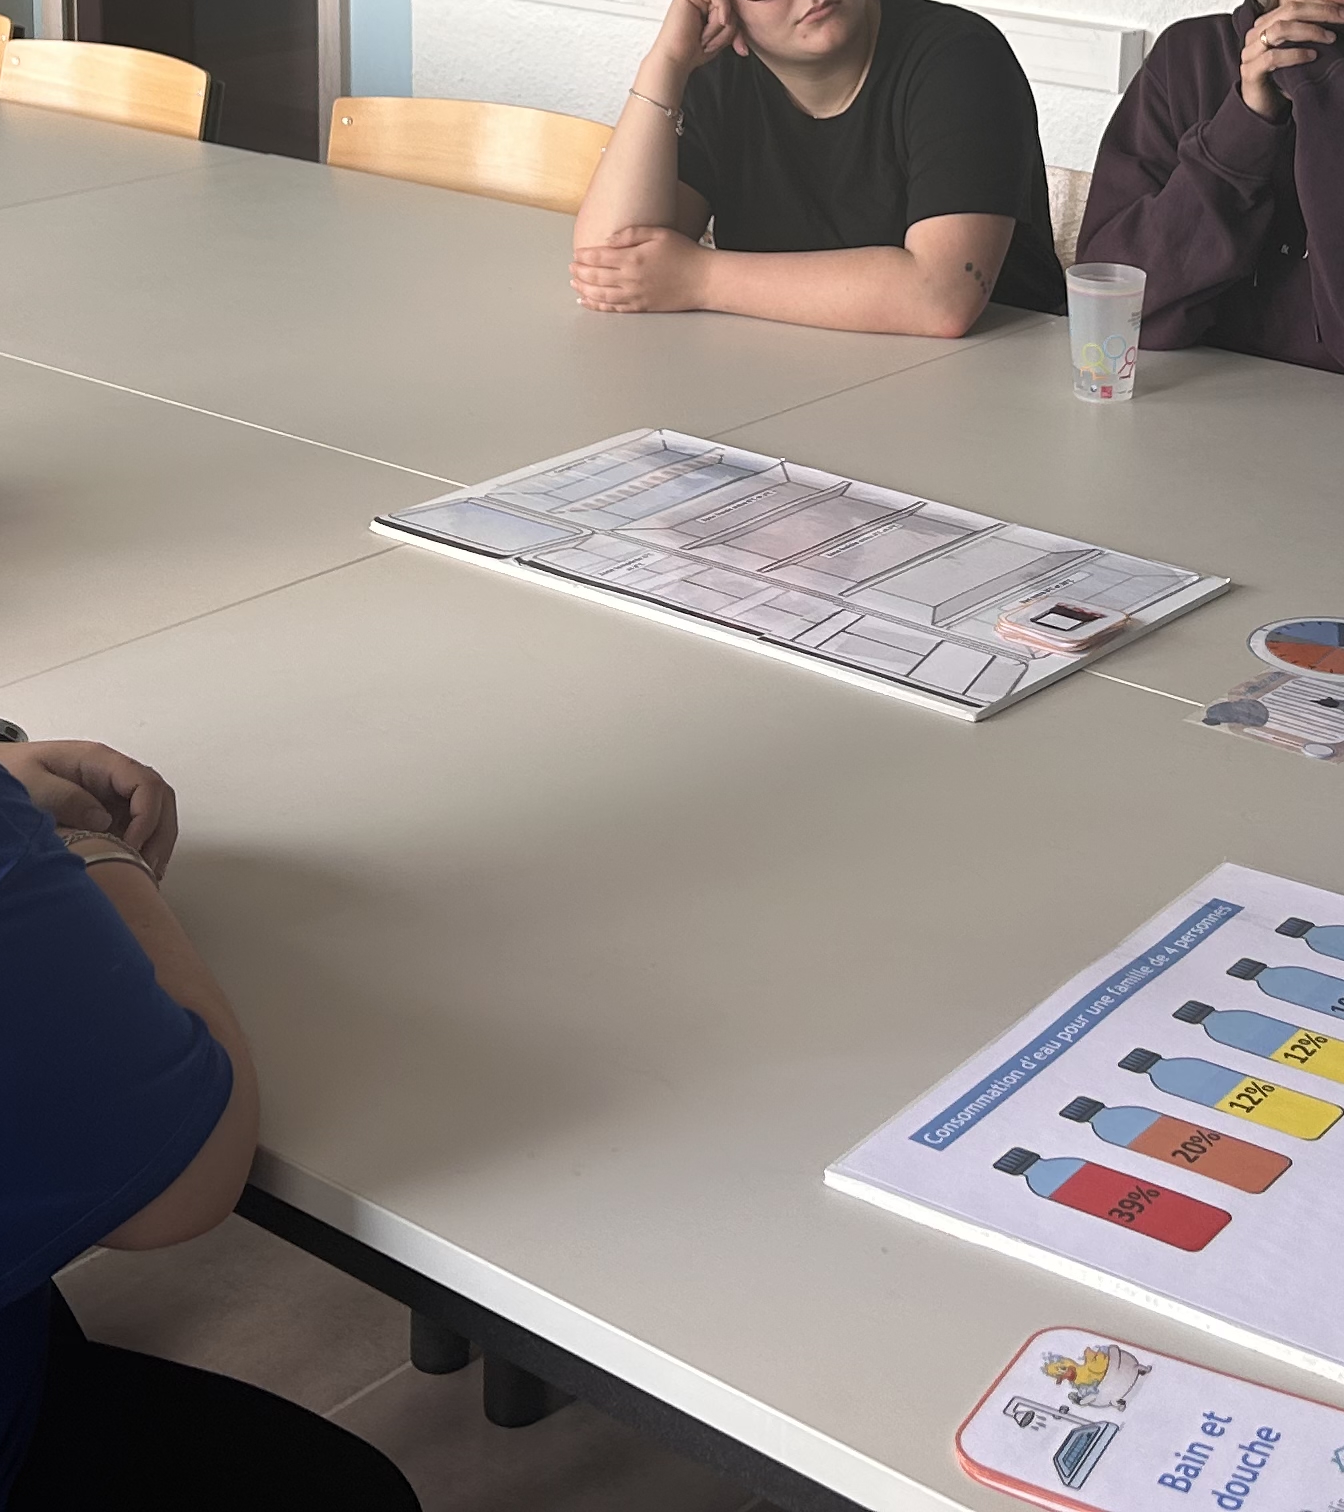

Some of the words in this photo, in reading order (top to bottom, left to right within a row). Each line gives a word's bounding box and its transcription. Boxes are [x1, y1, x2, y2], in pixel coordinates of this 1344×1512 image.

[923, 1068, 1025, 1146] Consommation
[1056, 1015, 1090, 1043] pour
[1088, 993, 1115, 1016] une
[1113, 963, 1154, 996] famille
[1148, 952, 1170, 968] de
[1165, 944, 1179, 956] 4
[1174, 904, 1233, 950] personnes
[1283, 1032, 1329, 1064] 12%
[1229, 1080, 1275, 1114] 12%
[1171, 1129, 1222, 1165] 20%
[1107, 1184, 1161, 1223] 39%
[1157, 1440, 1215, 1494] Bain
[1201, 1410, 1233, 1438] et
[1211, 1425, 1282, 1512] douche
